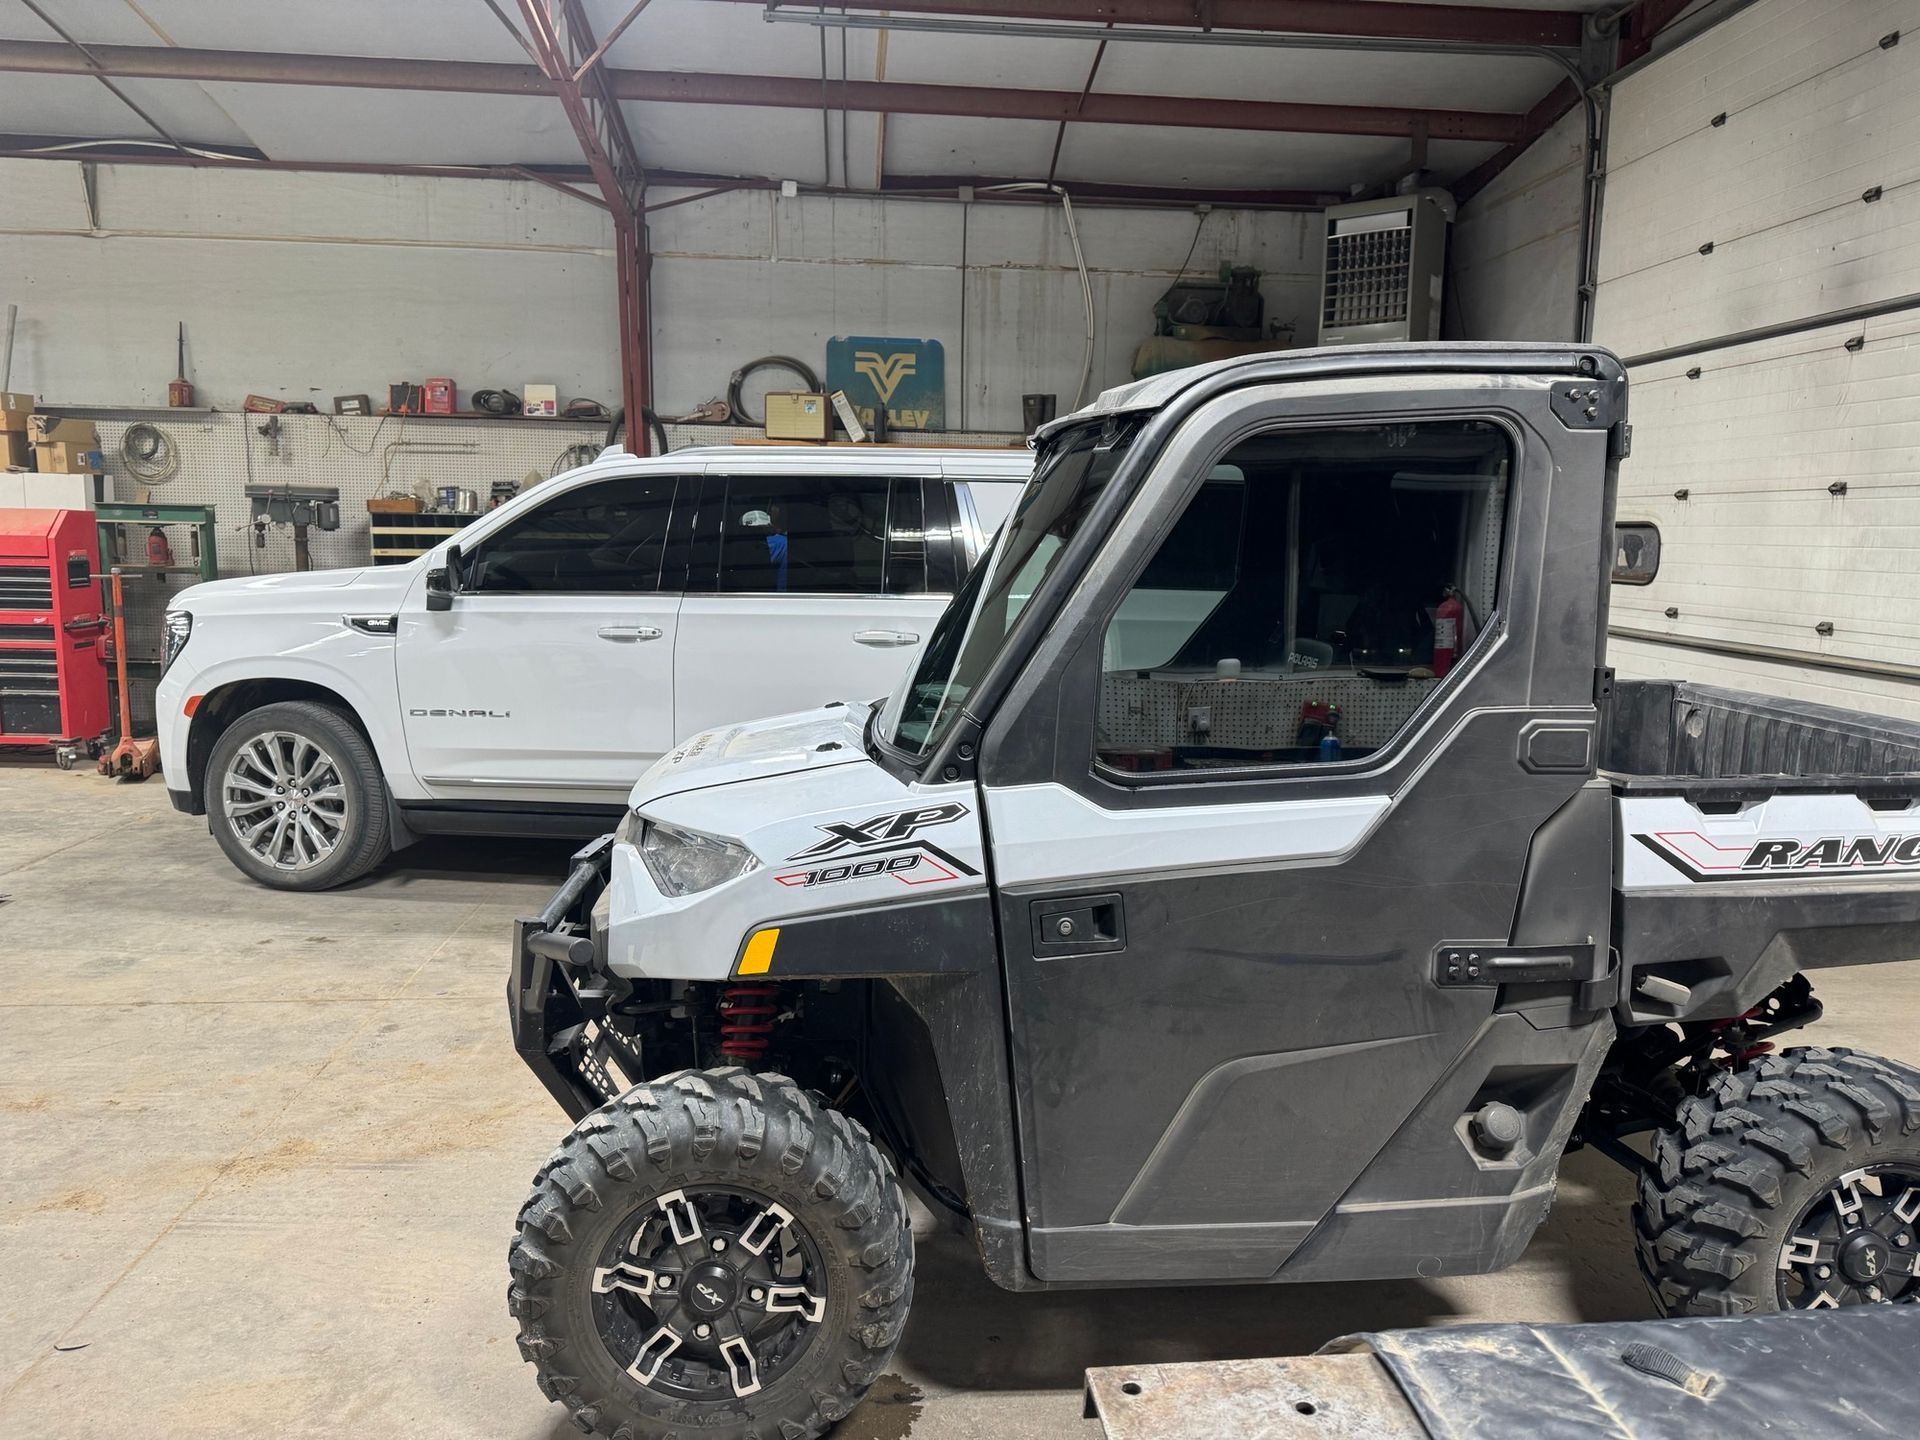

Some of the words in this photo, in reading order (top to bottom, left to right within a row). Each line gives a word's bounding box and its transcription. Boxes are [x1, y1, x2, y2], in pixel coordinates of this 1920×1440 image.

[853, 405, 930, 429] ALEY
[367, 619, 390, 627] GMC
[1288, 651, 1319, 669] POLARIS
[409, 709, 511, 718] DENALI
[784, 801, 971, 861] XP
[803, 852, 923, 888] 1000
[1865, 1248, 1877, 1277] XP
[695, 1282, 725, 1306] XP
